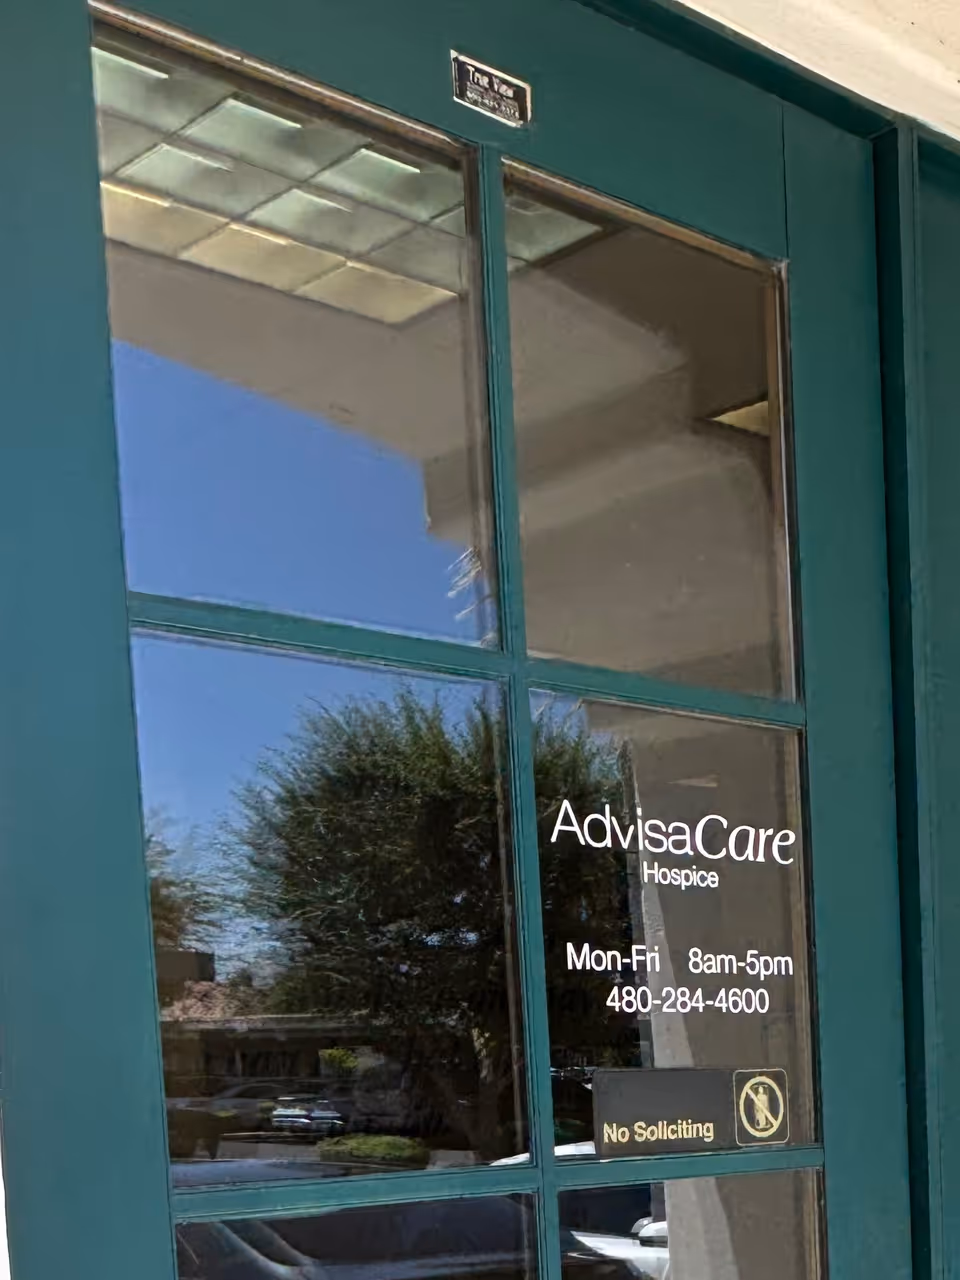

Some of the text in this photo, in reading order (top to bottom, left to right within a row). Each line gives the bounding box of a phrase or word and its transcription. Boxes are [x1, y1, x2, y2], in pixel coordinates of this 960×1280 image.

[550, 799, 797, 865] AdvisaCare
[642, 861, 720, 890] Hospice
[566, 942, 794, 980] Mon-Fri 8am-5pm
[606, 986, 770, 1014] 480-284-4600
[603, 1118, 714, 1143] No Soliciting
